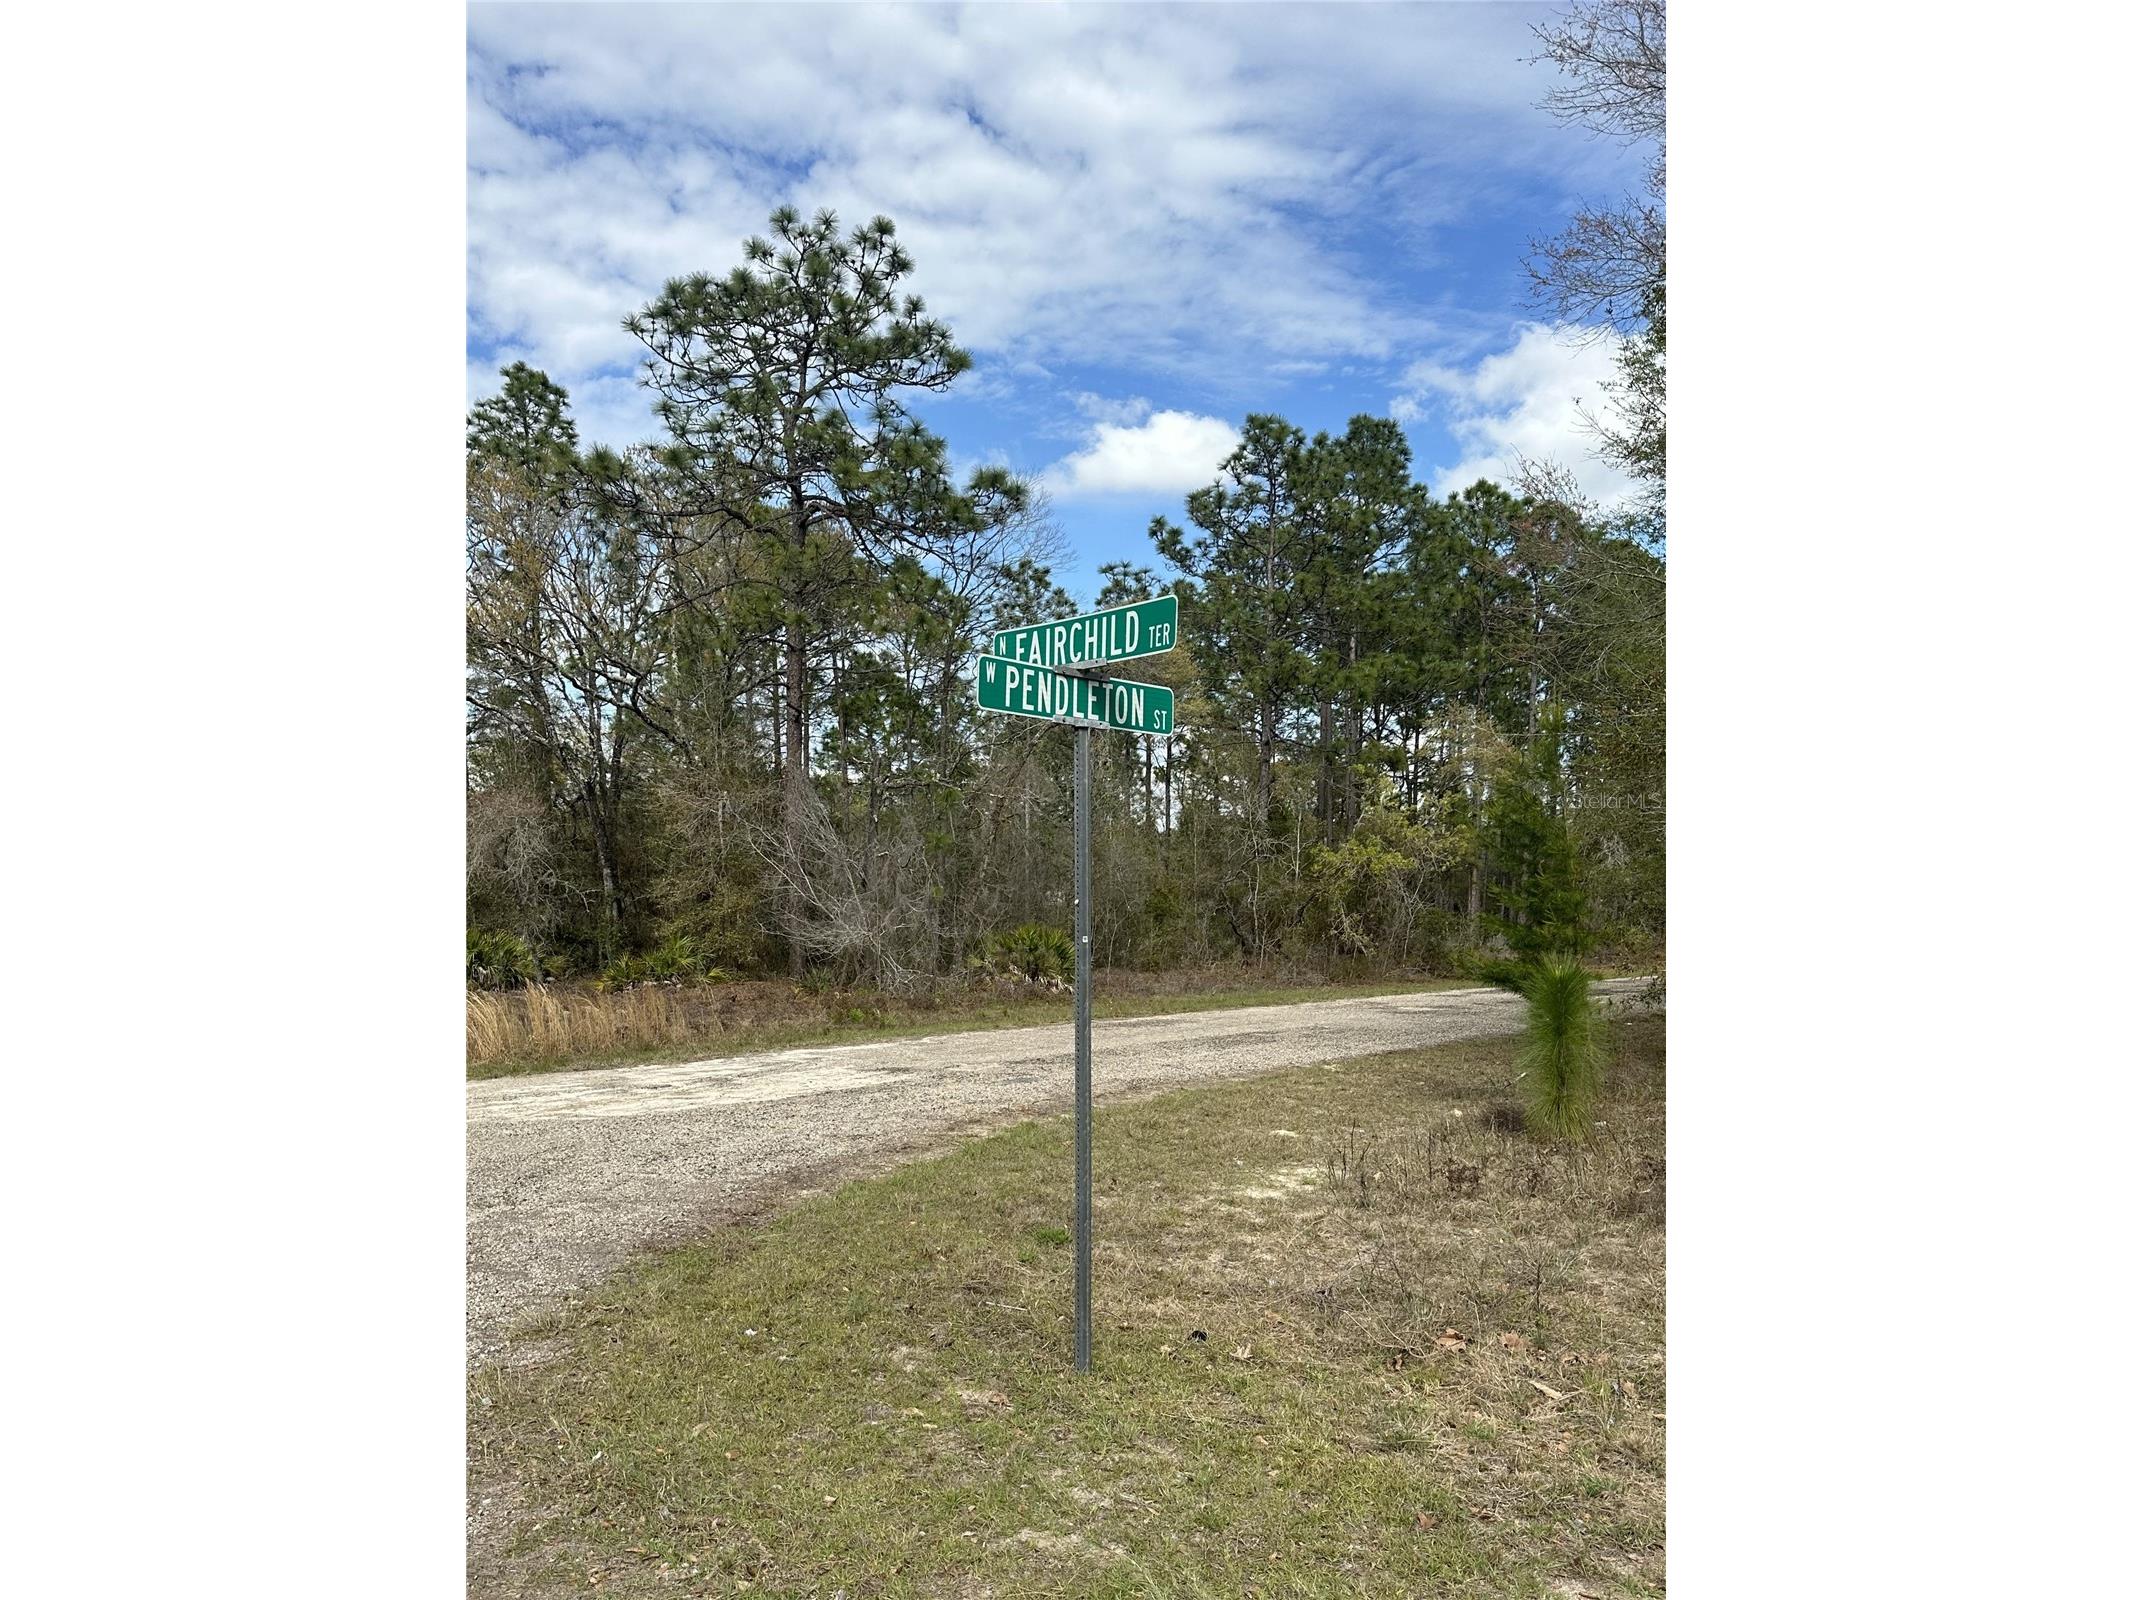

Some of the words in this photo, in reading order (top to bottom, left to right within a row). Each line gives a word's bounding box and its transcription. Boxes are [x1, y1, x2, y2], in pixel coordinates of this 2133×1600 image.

[999, 636, 1007, 655] N
[1016, 610, 1140, 667] FAIRCHILD
[1149, 623, 1170, 649] TER
[986, 661, 997, 683] W
[1005, 665, 1144, 727] PENDLETON
[1153, 709, 1167, 730] ST
